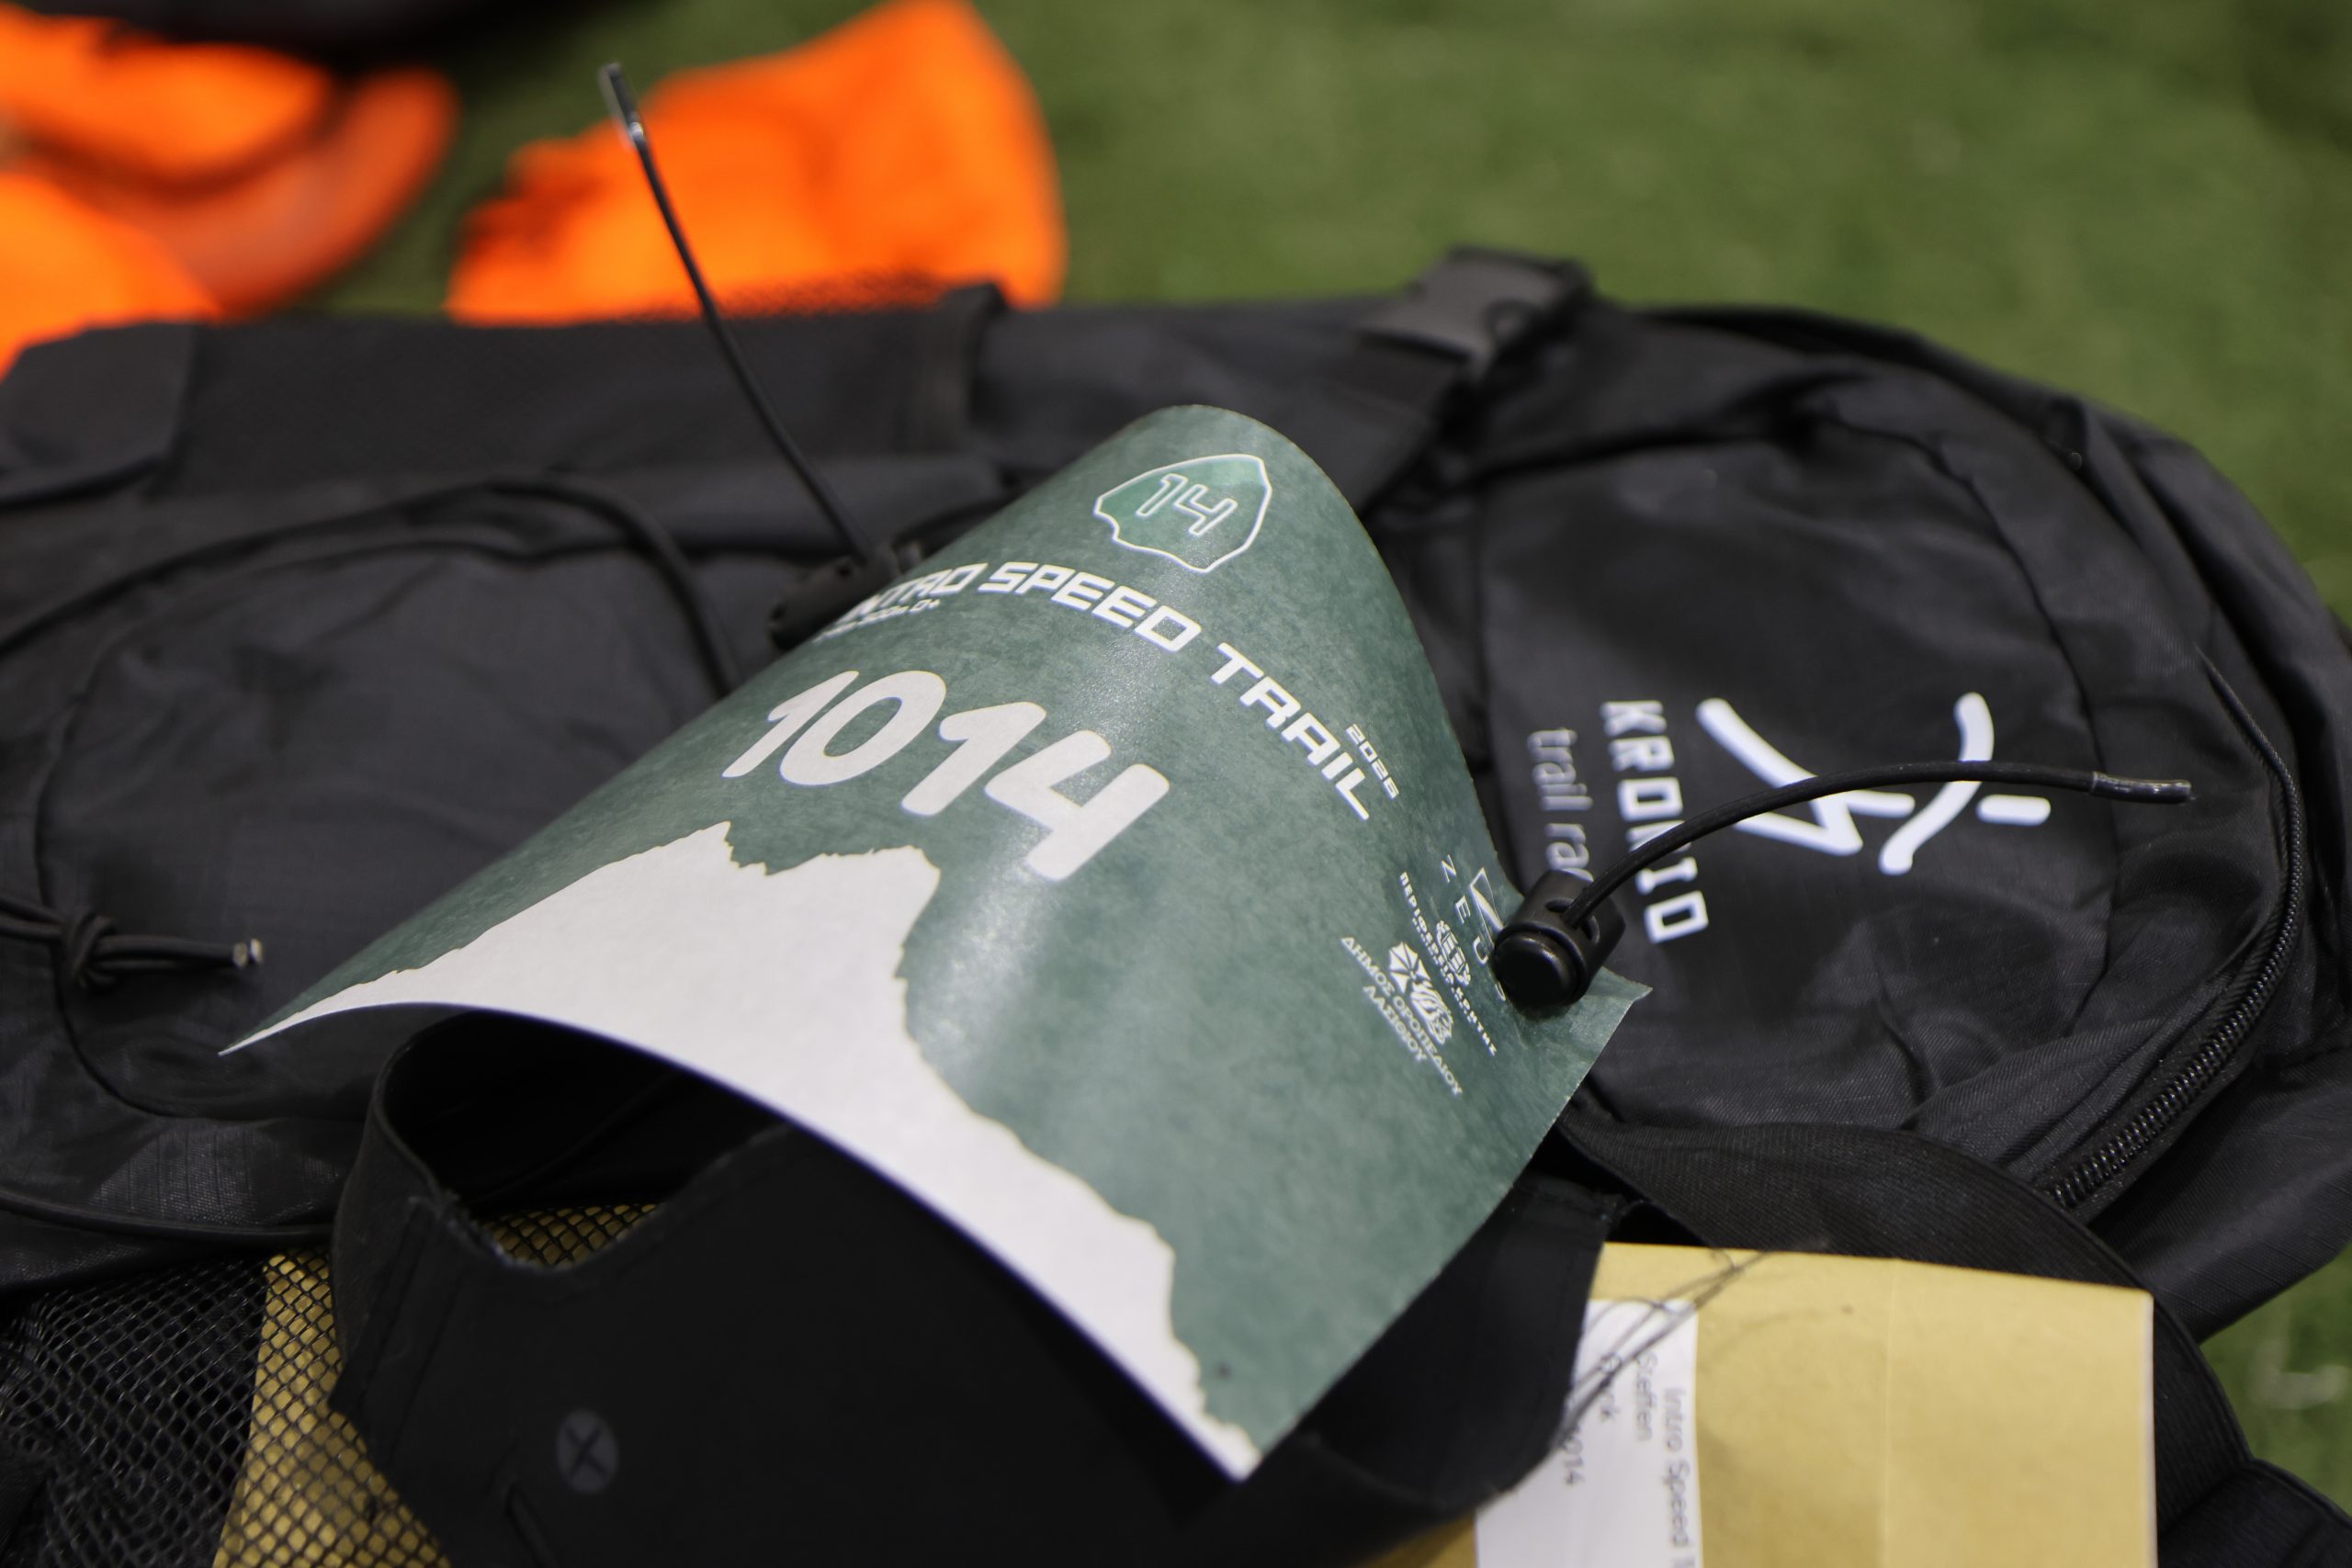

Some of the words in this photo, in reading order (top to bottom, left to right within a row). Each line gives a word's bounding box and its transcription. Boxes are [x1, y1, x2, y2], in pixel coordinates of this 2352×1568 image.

[1136, 472, 1238, 537] 14
[834, 562, 989, 626] NTRO
[977, 560, 1203, 653] SPEED
[1209, 642, 1370, 820] TRAIL
[721, 670, 1170, 882] 1014
[1345, 723, 1400, 801] 2026
[1526, 727, 1593, 812] trail
[1544, 822, 1595, 883] ra
[1340, 936, 1396, 998] ΔΗΜΟΣ
[1392, 994, 1464, 1096] ΟΡΟΠΕΔΙΟΥ
[1664, 1387, 1686, 1452] Intro
[1663, 1461, 1693, 1548] Speed
